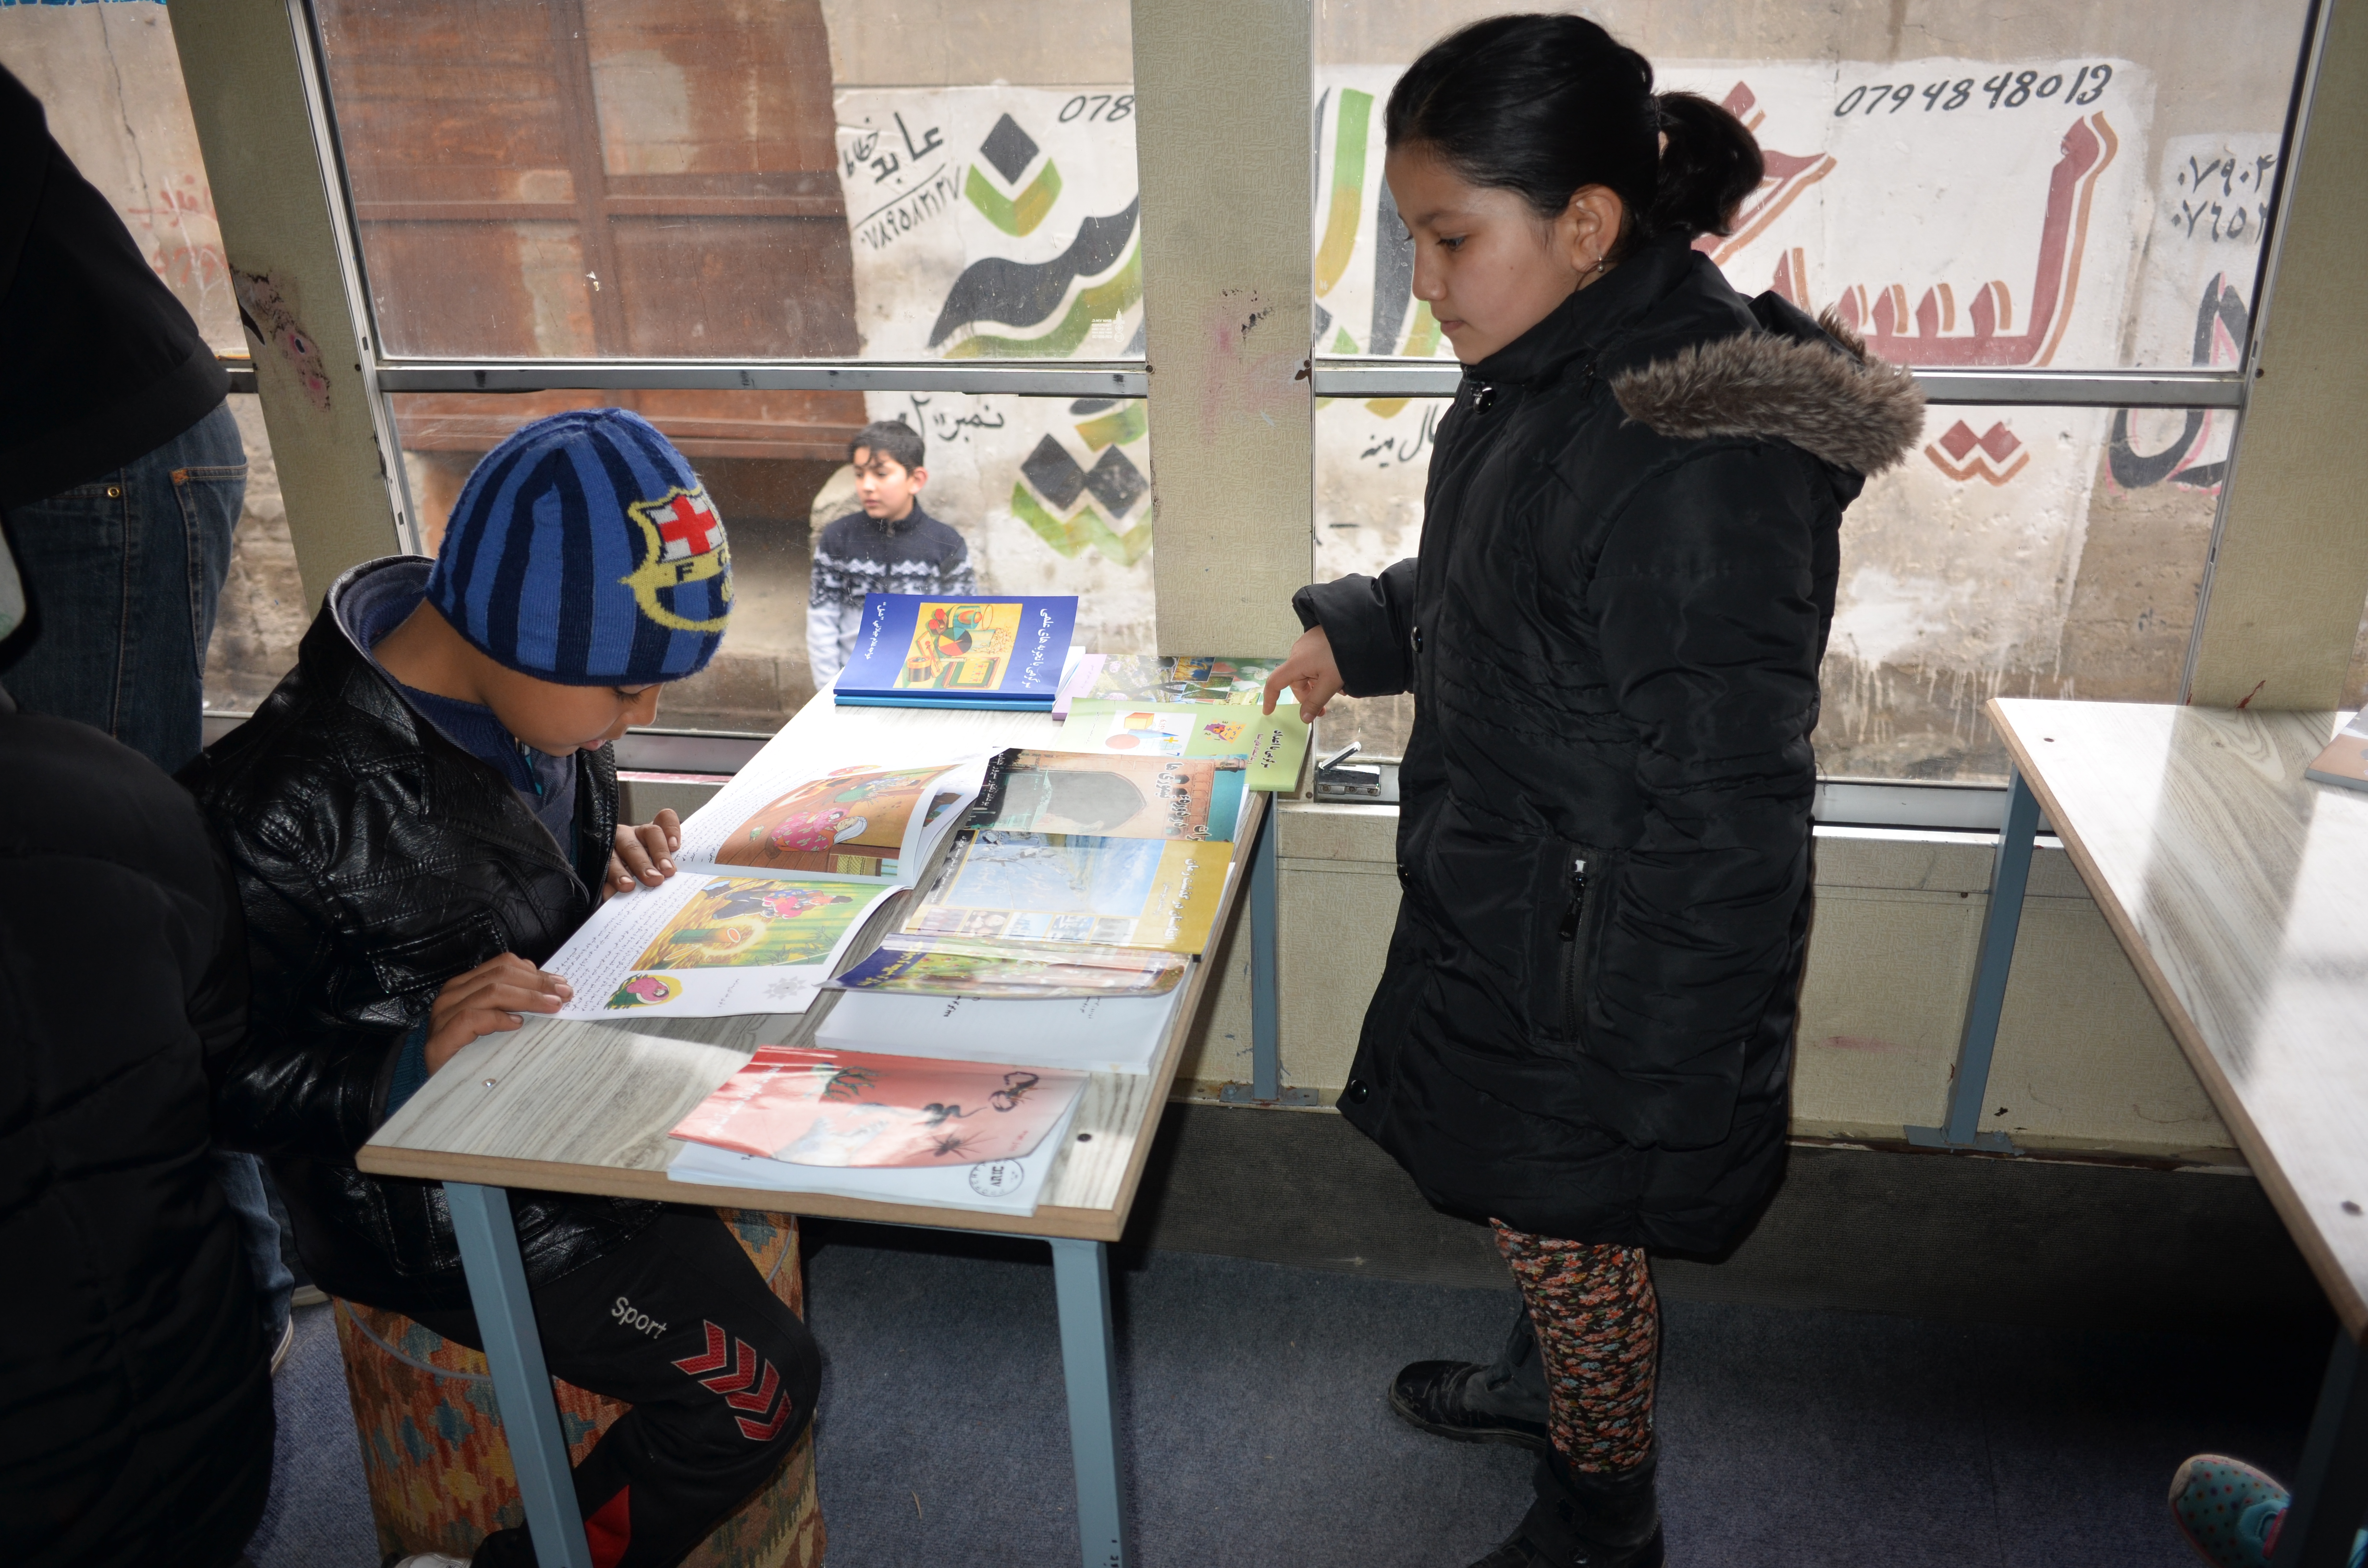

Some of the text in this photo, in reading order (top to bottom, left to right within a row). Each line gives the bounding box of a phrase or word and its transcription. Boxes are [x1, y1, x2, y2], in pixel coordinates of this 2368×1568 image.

[938, 404, 1004, 442] نمبر
[1040, 608, 1054, 628] علمی
[1038, 628, 1051, 644] های
[1270, 730, 1284, 746] اعداد
[1154, 762, 1184, 798] تیموری ها
[1168, 817, 1189, 828] در
[1185, 825, 1212, 841] رات
[1164, 858, 1200, 940] افغانستان در گذشت زمان
[990, 1166, 1004, 1187] ARIC
[610, 1296, 667, 1340] Sport
